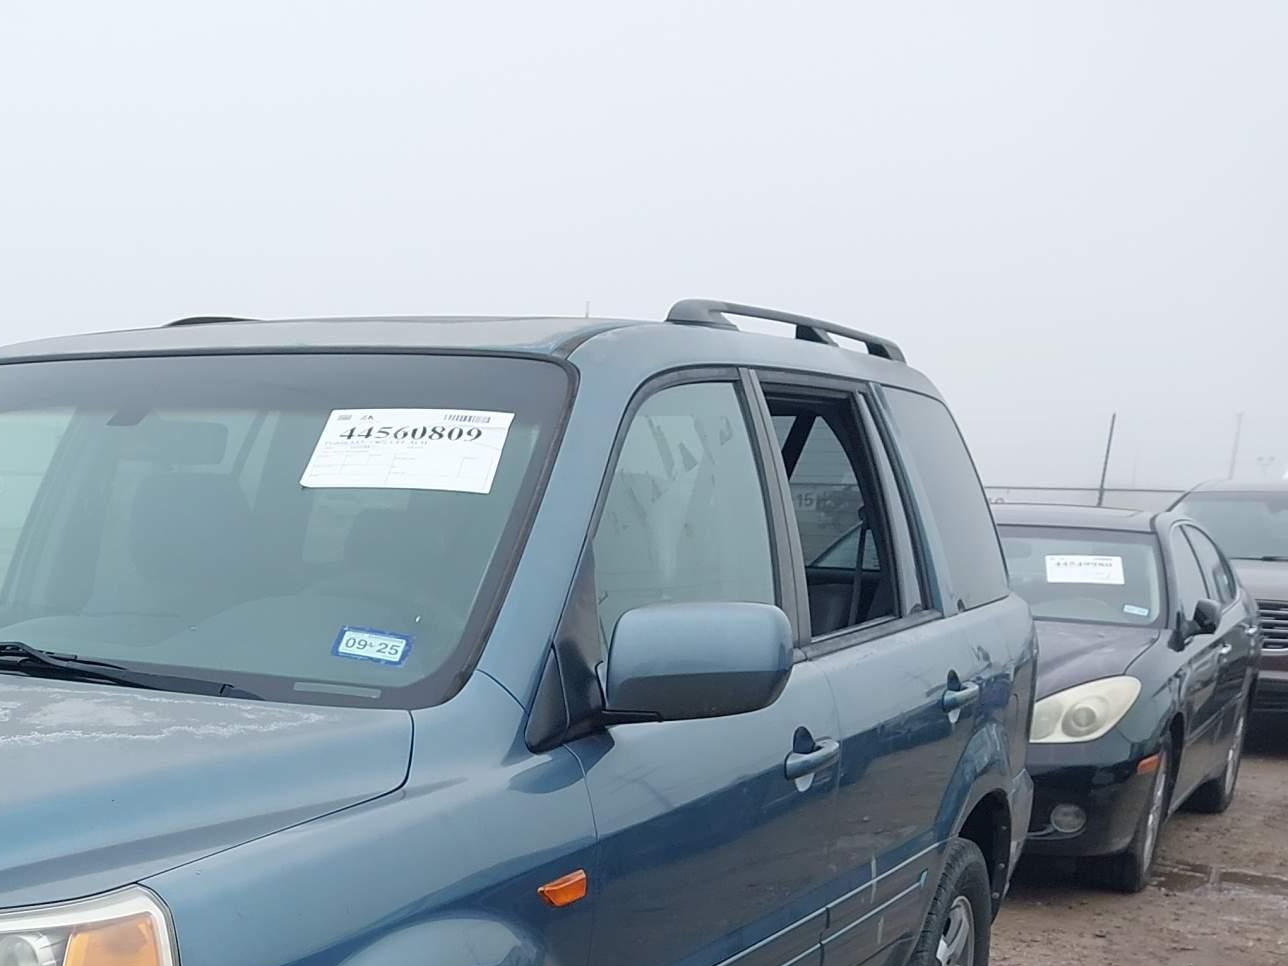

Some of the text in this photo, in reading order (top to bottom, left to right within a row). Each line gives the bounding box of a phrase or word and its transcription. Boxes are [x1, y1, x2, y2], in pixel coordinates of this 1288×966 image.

[339, 426, 483, 441] 44560809
[345, 637, 401, 656] 09 25
